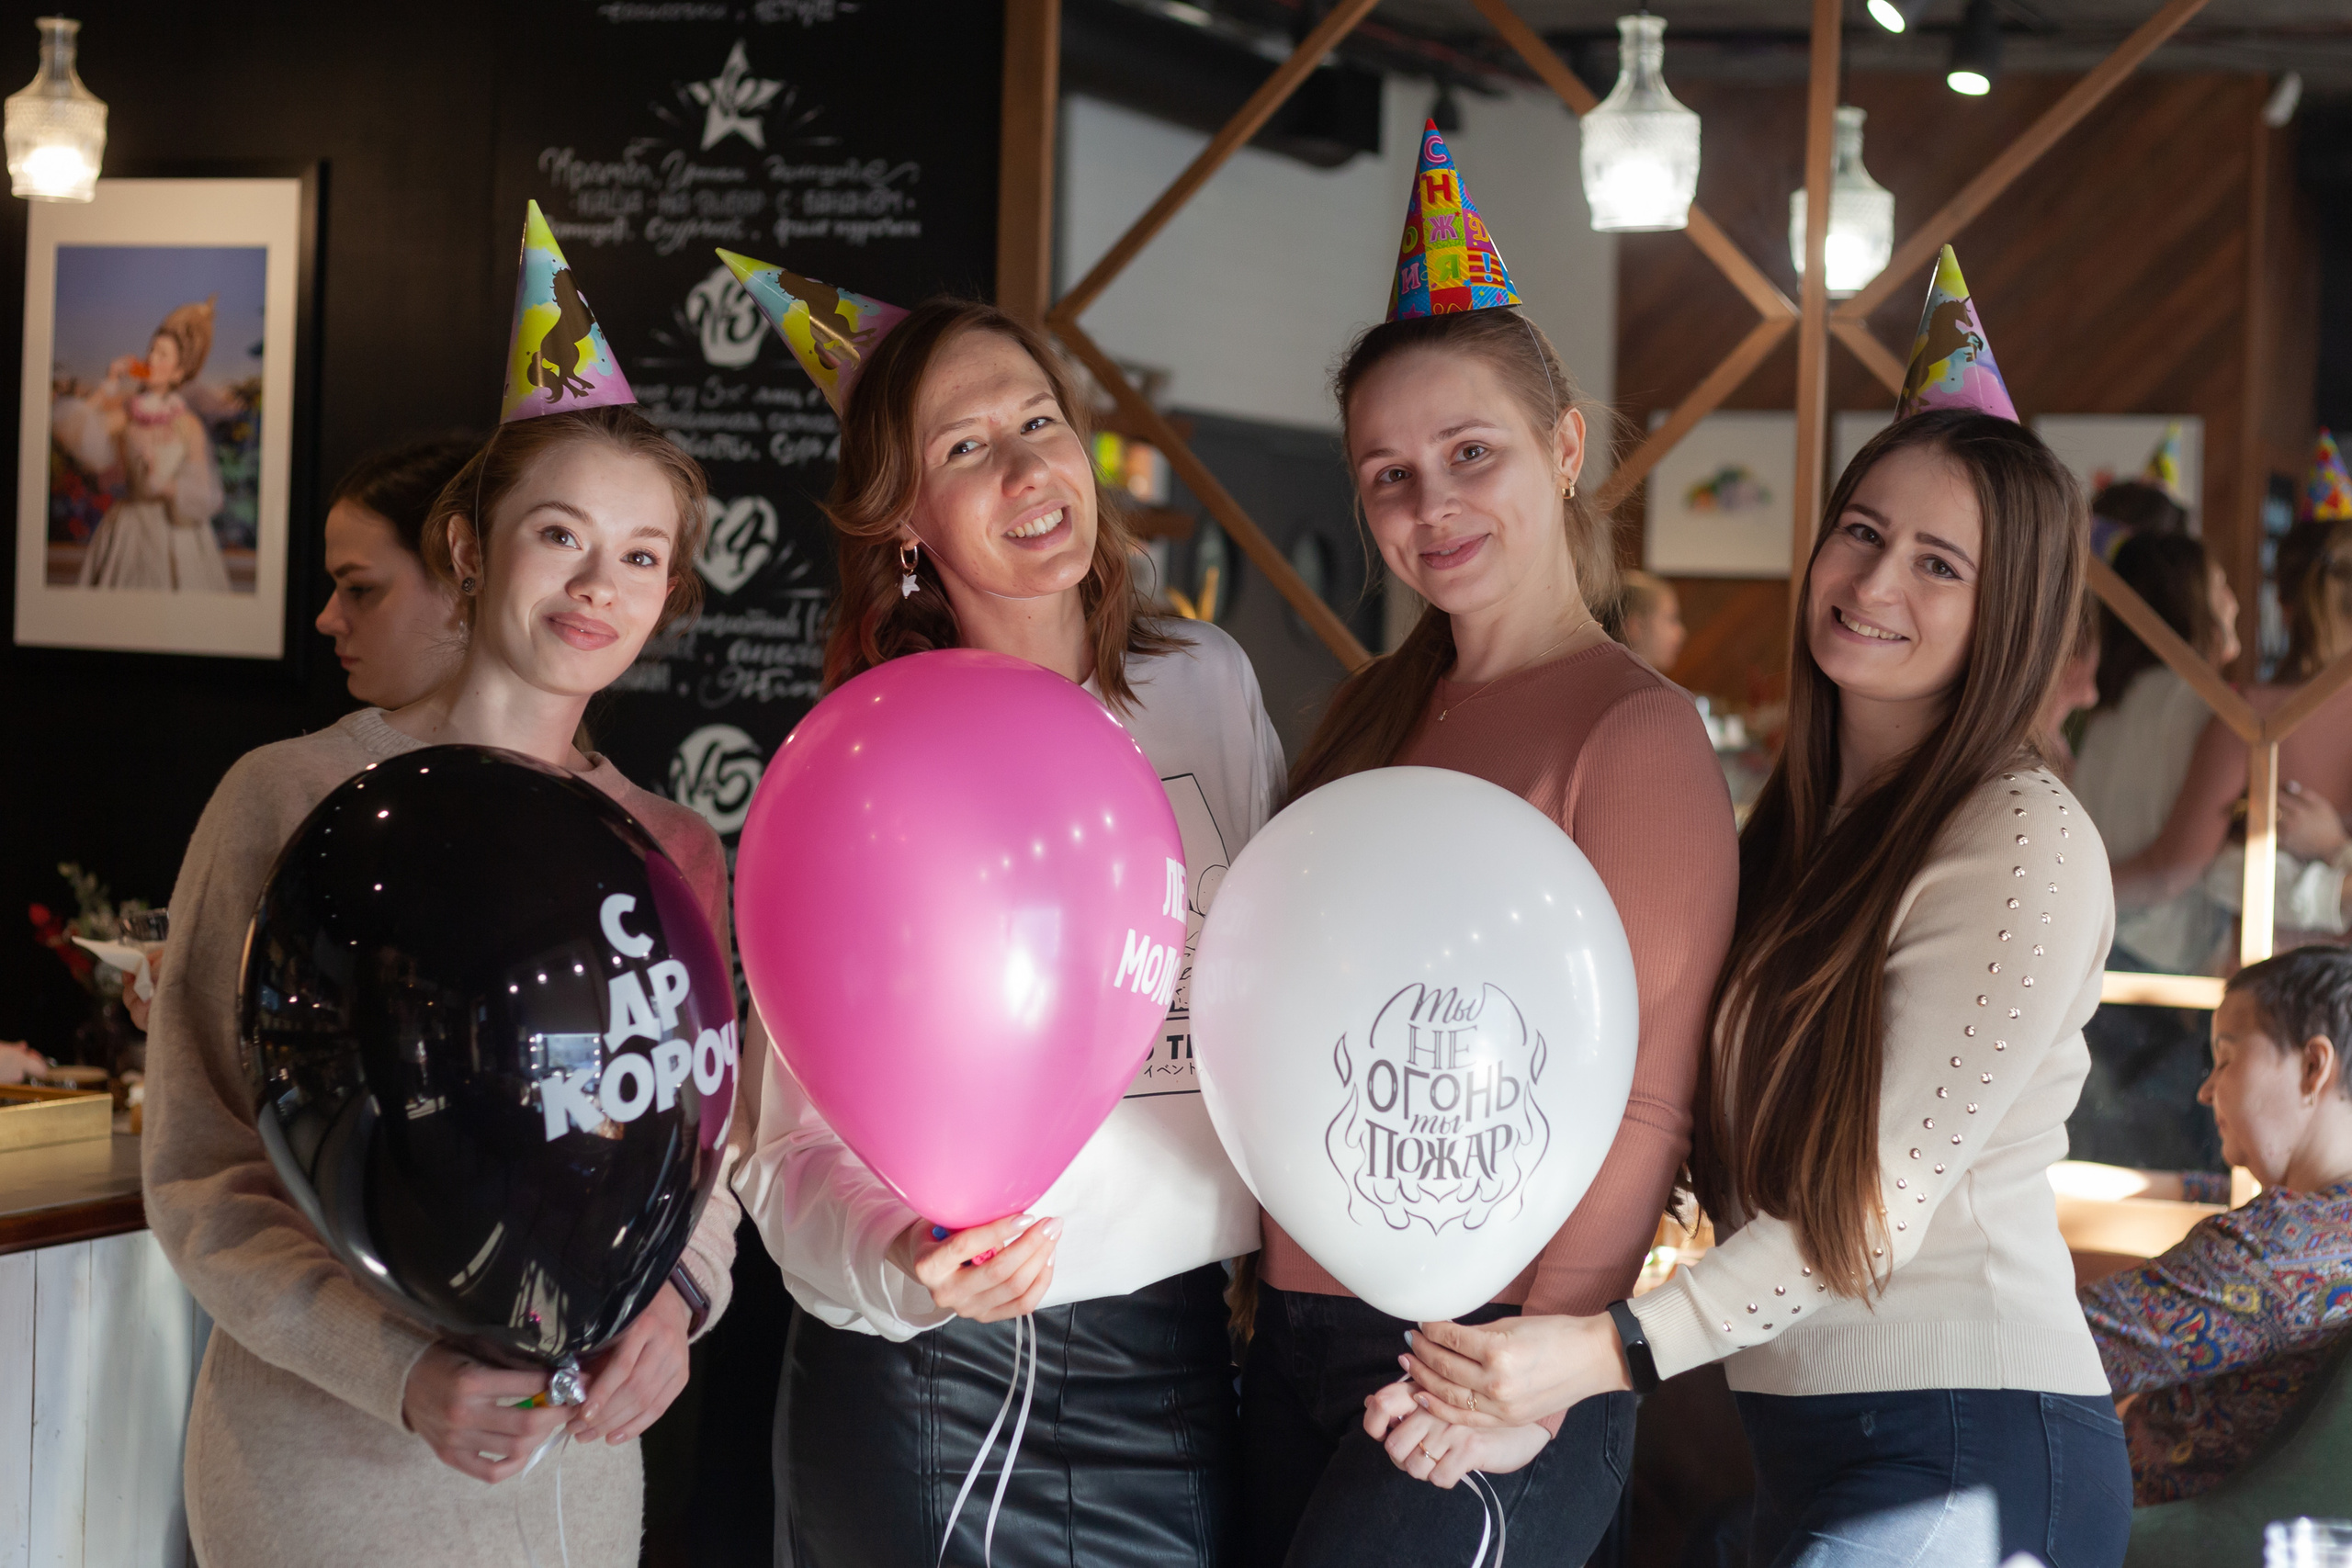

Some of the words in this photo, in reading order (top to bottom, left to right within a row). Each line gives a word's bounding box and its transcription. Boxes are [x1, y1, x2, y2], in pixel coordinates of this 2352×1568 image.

[600, 892, 654, 959] С
[603, 958, 690, 1055] ДР
[1407, 1023, 1477, 1070] НЕ
[1367, 1059, 1521, 1123] ОГОНЬ
[1364, 1122, 1514, 1182] ПОЖАР
[1408, 1113, 1464, 1135] ты
